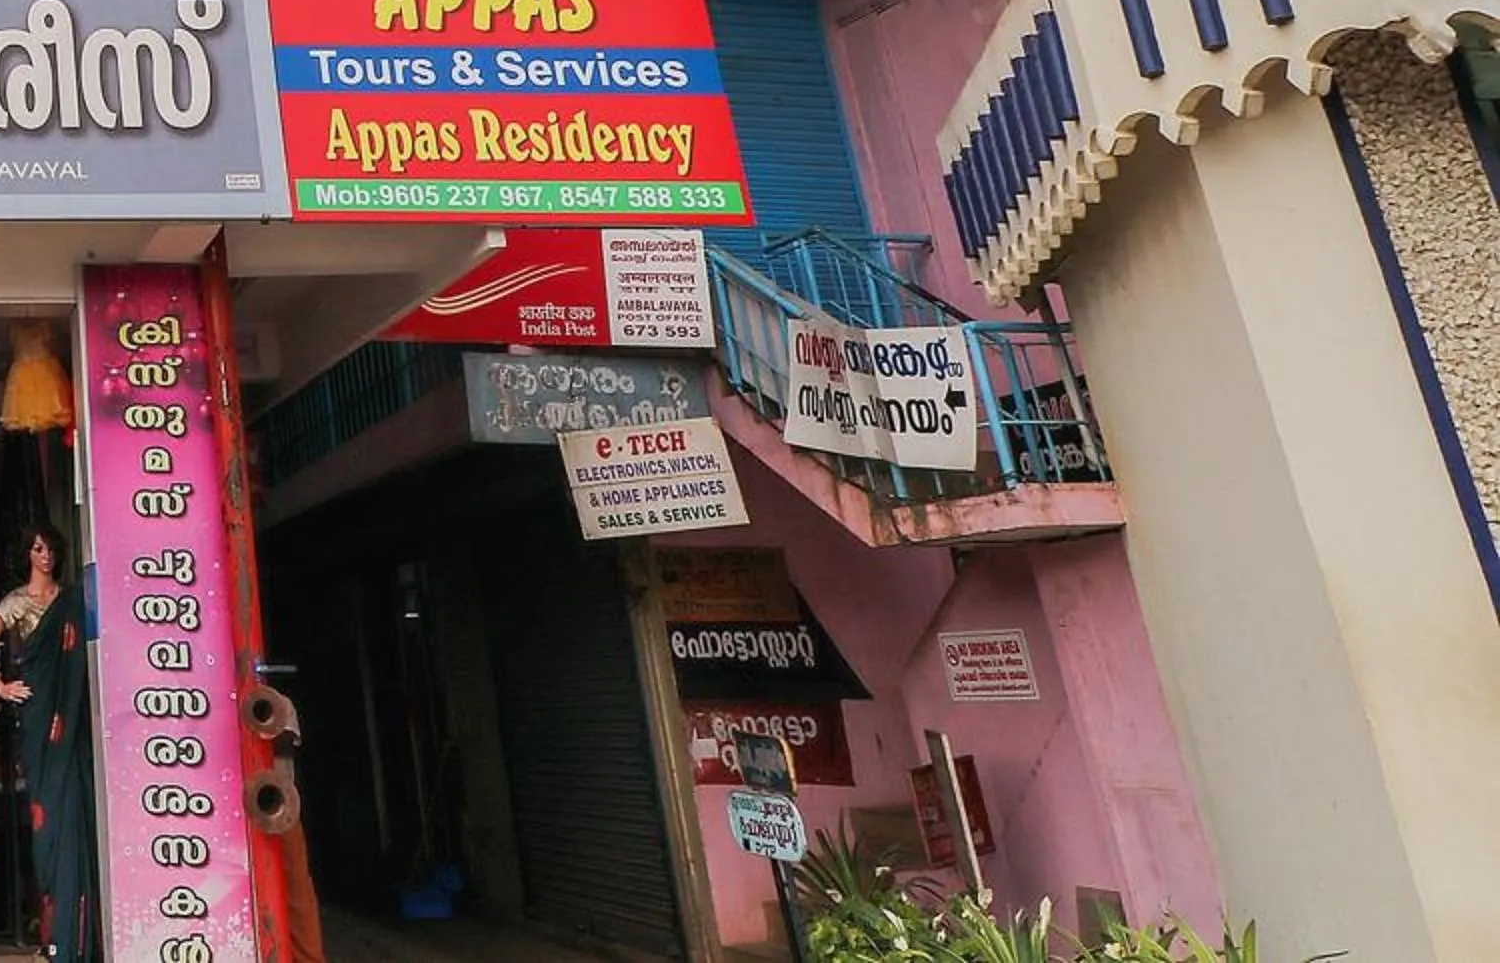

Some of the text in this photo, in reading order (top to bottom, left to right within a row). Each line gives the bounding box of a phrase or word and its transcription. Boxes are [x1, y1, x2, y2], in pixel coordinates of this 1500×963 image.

[308, 49, 690, 89] Tours & Services
[326, 107, 694, 177] Appas Residency
[447, 184, 490, 207] 237
[561, 185, 621, 209] 8547
[628, 186, 673, 209] 588
[681, 187, 727, 210] 333
[518, 303, 597, 322] भारतीय डाक
[617, 299, 703, 313] AMBALAVAYAL
[519, 321, 597, 337] India Post
[617, 313, 703, 323] POST OFFICE
[623, 324, 702, 339] 673 593
[589, 479, 727, 507] & HOME APPLIANCES
[597, 503, 727, 530] SALES & SERVICE
